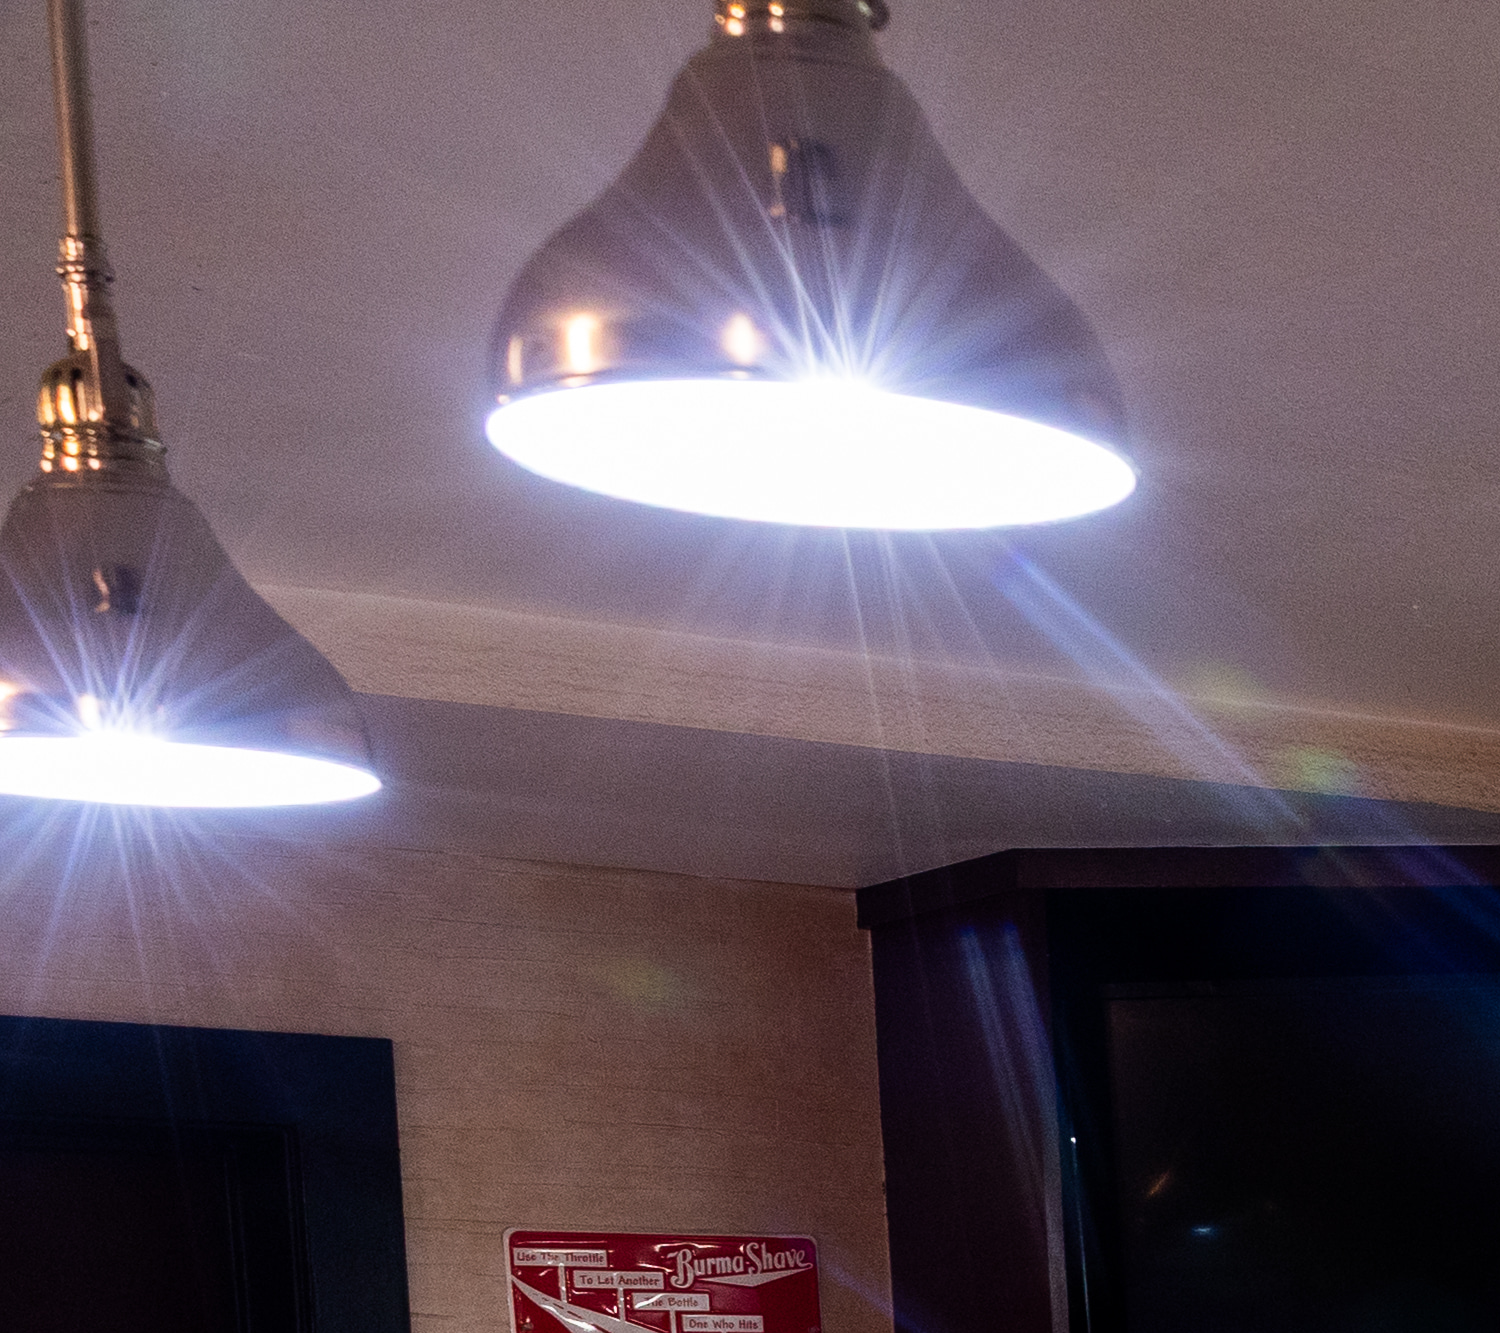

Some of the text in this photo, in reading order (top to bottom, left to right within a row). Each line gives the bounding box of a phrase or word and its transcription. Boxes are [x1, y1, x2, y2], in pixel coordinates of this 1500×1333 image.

[579, 1275, 661, 1287] To Let Another
[688, 1319, 709, 1330] One
[712, 1319, 735, 1330] Who
